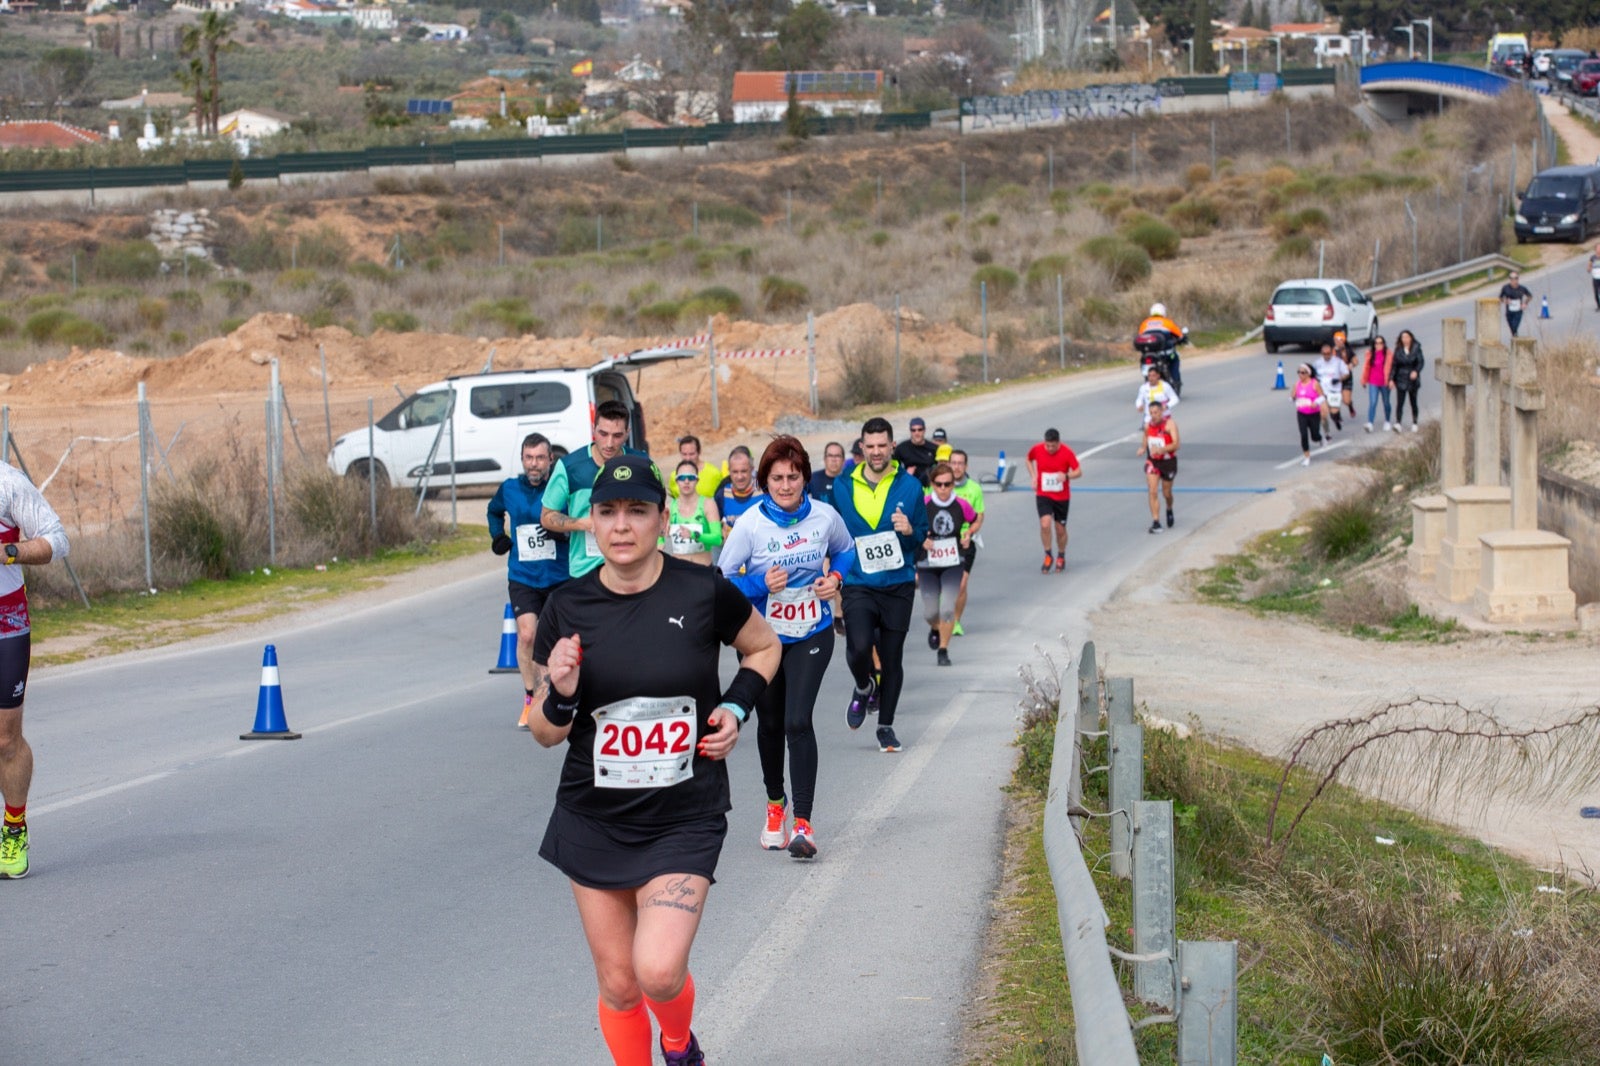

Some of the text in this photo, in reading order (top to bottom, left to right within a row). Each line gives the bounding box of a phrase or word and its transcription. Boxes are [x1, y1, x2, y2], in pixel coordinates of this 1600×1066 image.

[528, 537, 545, 549] 65
[772, 551, 822, 567] MARACENA
[865, 543, 894, 561] 838
[930, 546, 957, 558] 2014
[770, 600, 817, 621] 2011
[600, 720, 690, 757] 2042
